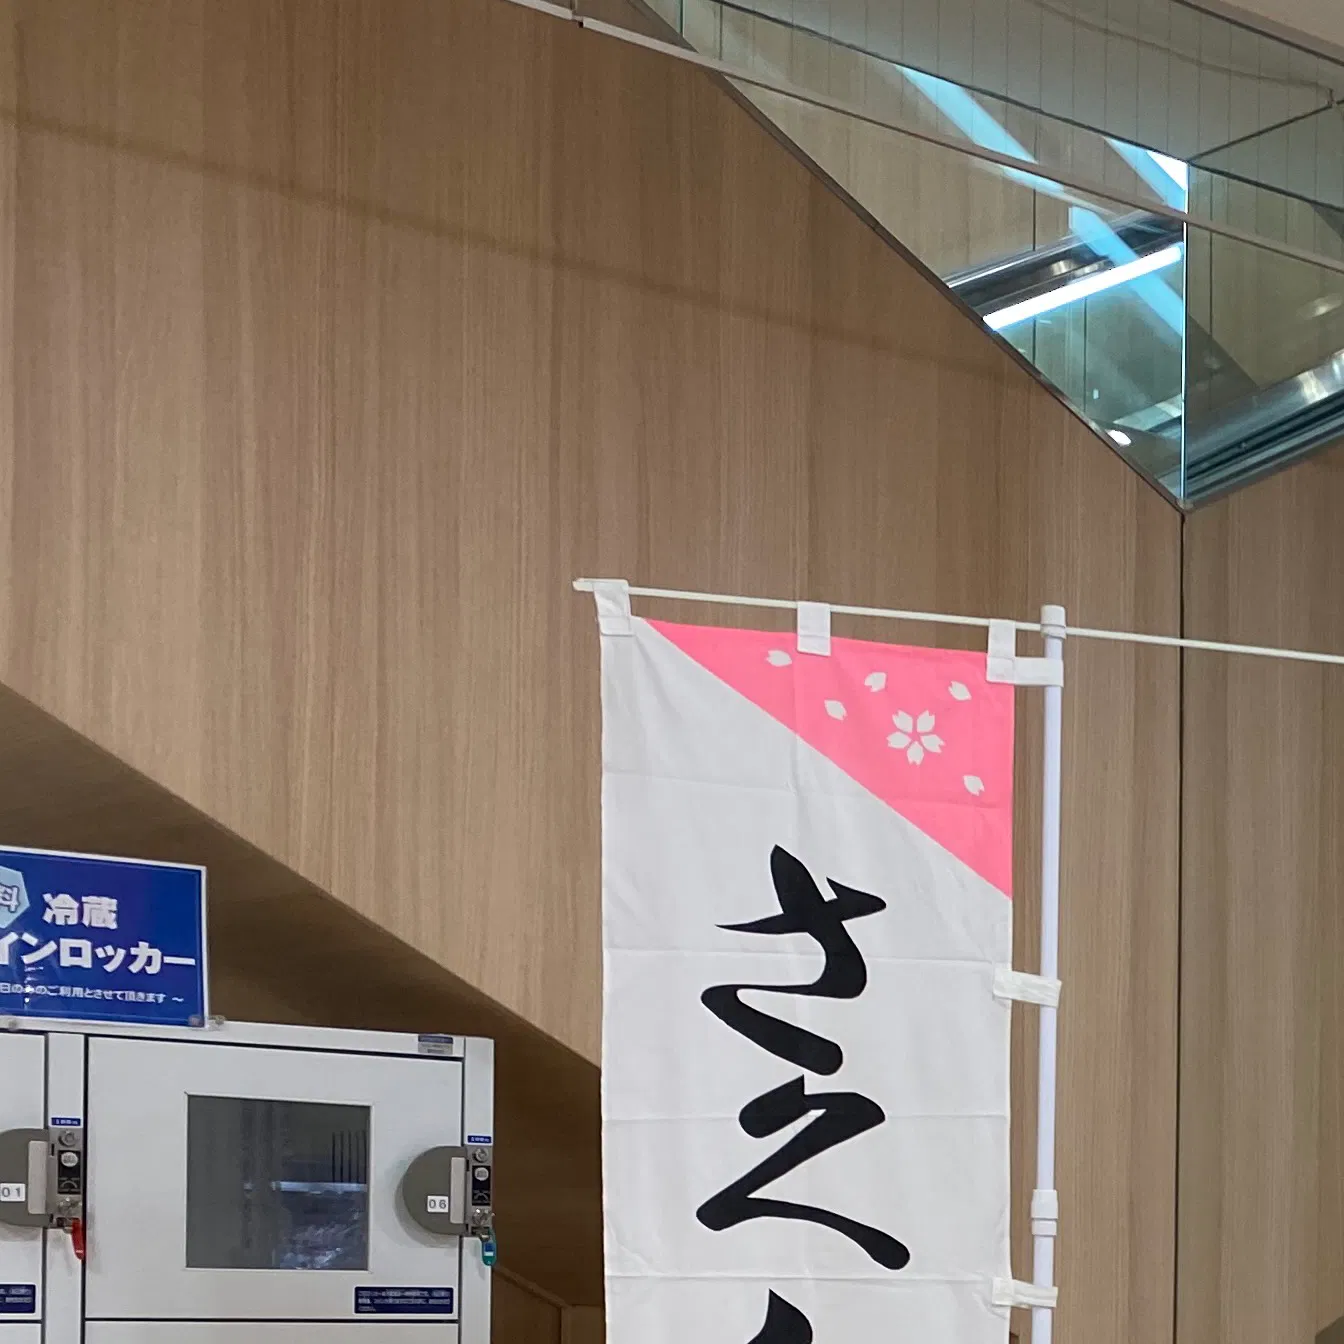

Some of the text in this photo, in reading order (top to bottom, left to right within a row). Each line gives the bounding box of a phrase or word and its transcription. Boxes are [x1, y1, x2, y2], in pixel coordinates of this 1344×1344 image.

[42, 892, 118, 929] 冷蔵
[1, 1186, 21, 1198] 01
[428, 1199, 447, 1210] 06
